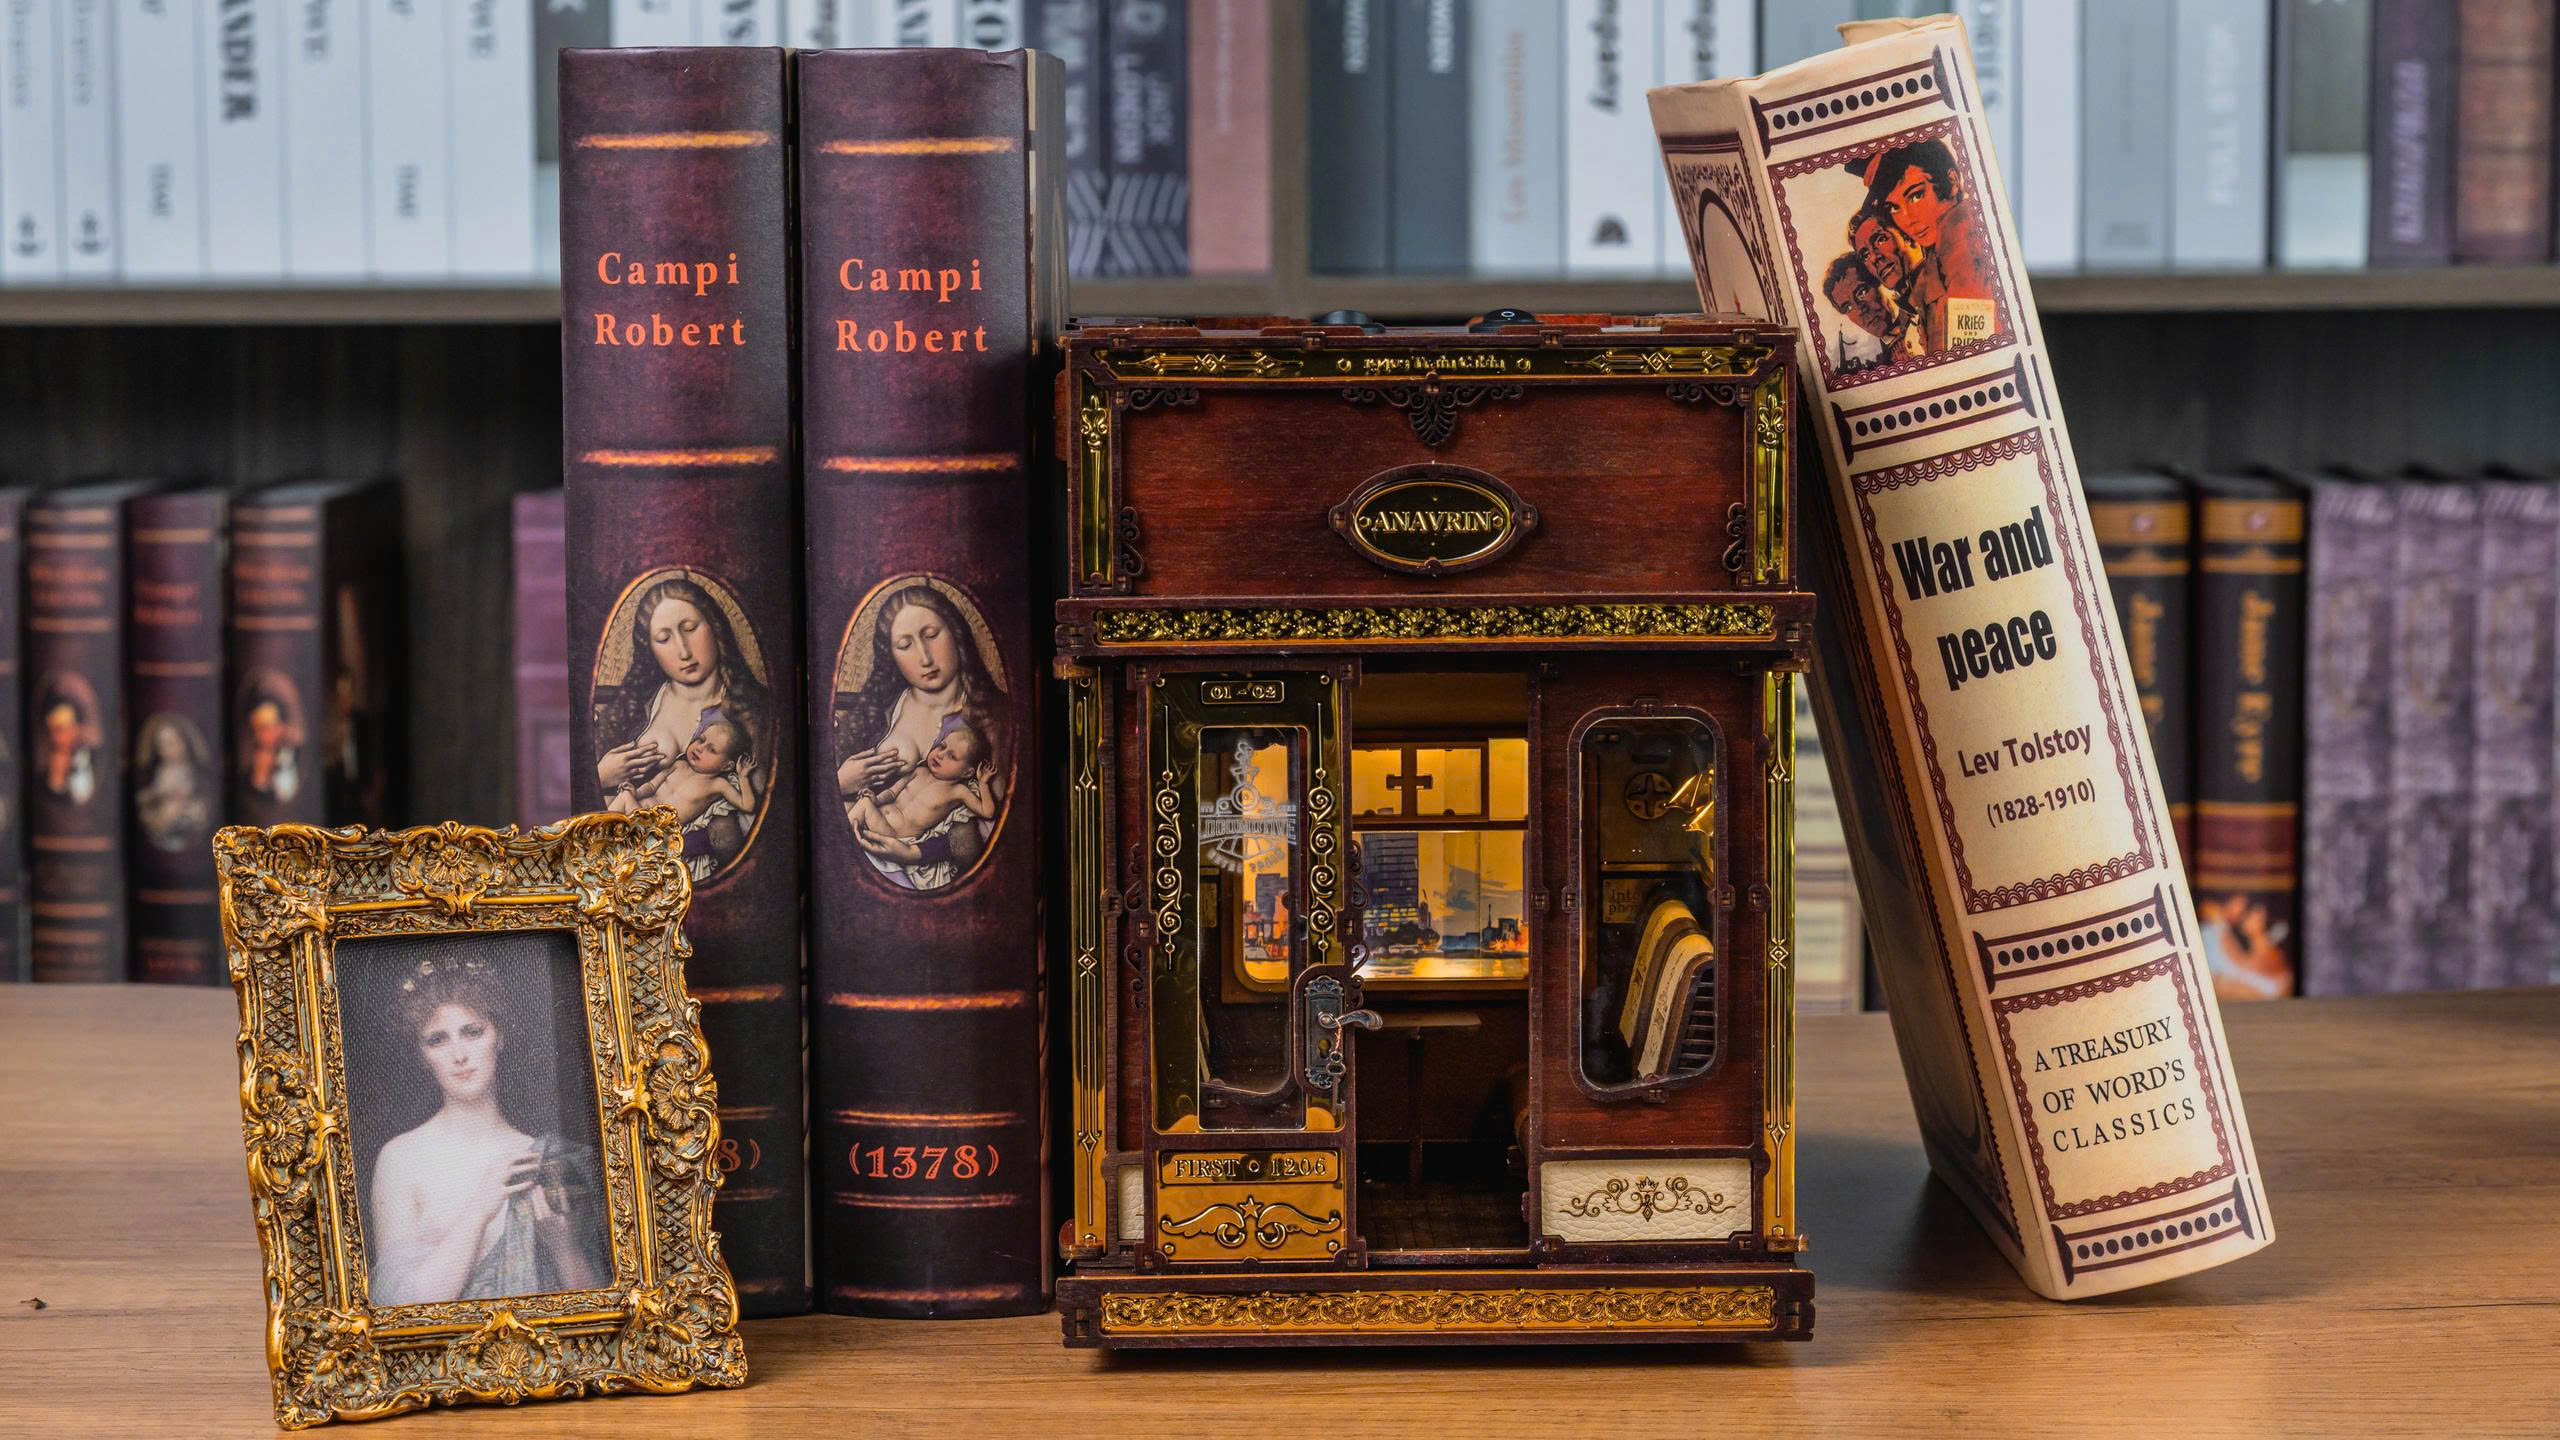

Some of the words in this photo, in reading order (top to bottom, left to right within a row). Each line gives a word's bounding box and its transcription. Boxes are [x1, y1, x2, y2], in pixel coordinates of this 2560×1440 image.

[598, 253, 740, 296] Campi
[840, 258, 982, 303] Campi
[594, 313, 746, 346] Robert
[836, 320, 988, 353] Robert
[1371, 511, 1492, 533] ANAVRIN
[1892, 536, 1975, 601] War
[1979, 505, 2054, 582] and
[1936, 610, 2057, 692] peace
[1958, 750, 1999, 778] Lev
[2002, 724, 2091, 767] Tolstoy
[1986, 778, 2096, 828] (1828-1910)
[2034, 1050, 2052, 1073] A
[2051, 1016, 2173, 1068] TREASURY
[2042, 1088, 2075, 1114] OF
[2085, 1059, 2186, 1105] WORD'S
[2053, 1097, 2196, 1152] CLASSICS
[849, 1142, 1000, 1181] (1378)
[1174, 1158, 1240, 1178] FIRST
[1271, 1158, 1328, 1177] 1206
